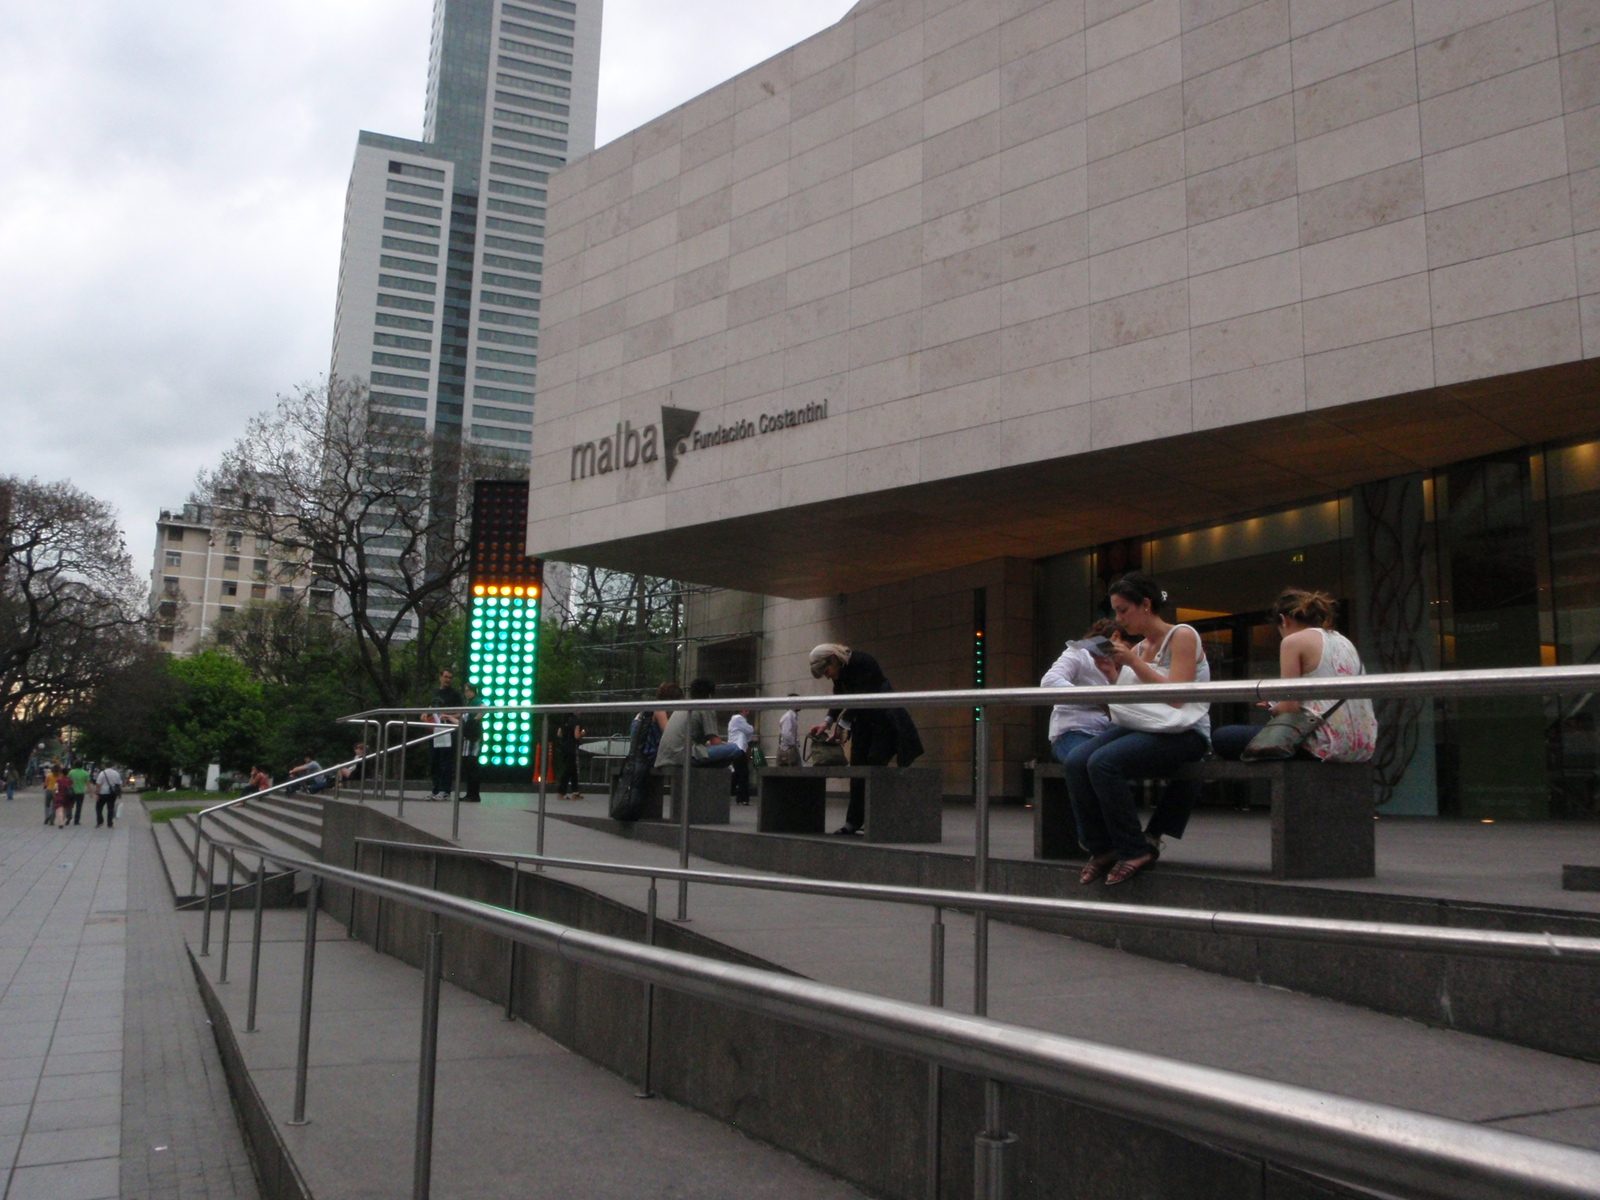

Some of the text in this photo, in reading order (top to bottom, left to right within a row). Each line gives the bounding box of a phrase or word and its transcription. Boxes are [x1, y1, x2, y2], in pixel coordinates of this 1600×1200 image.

[570, 419, 659, 482] malba
[693, 398, 829, 450] Fundación Costantini
